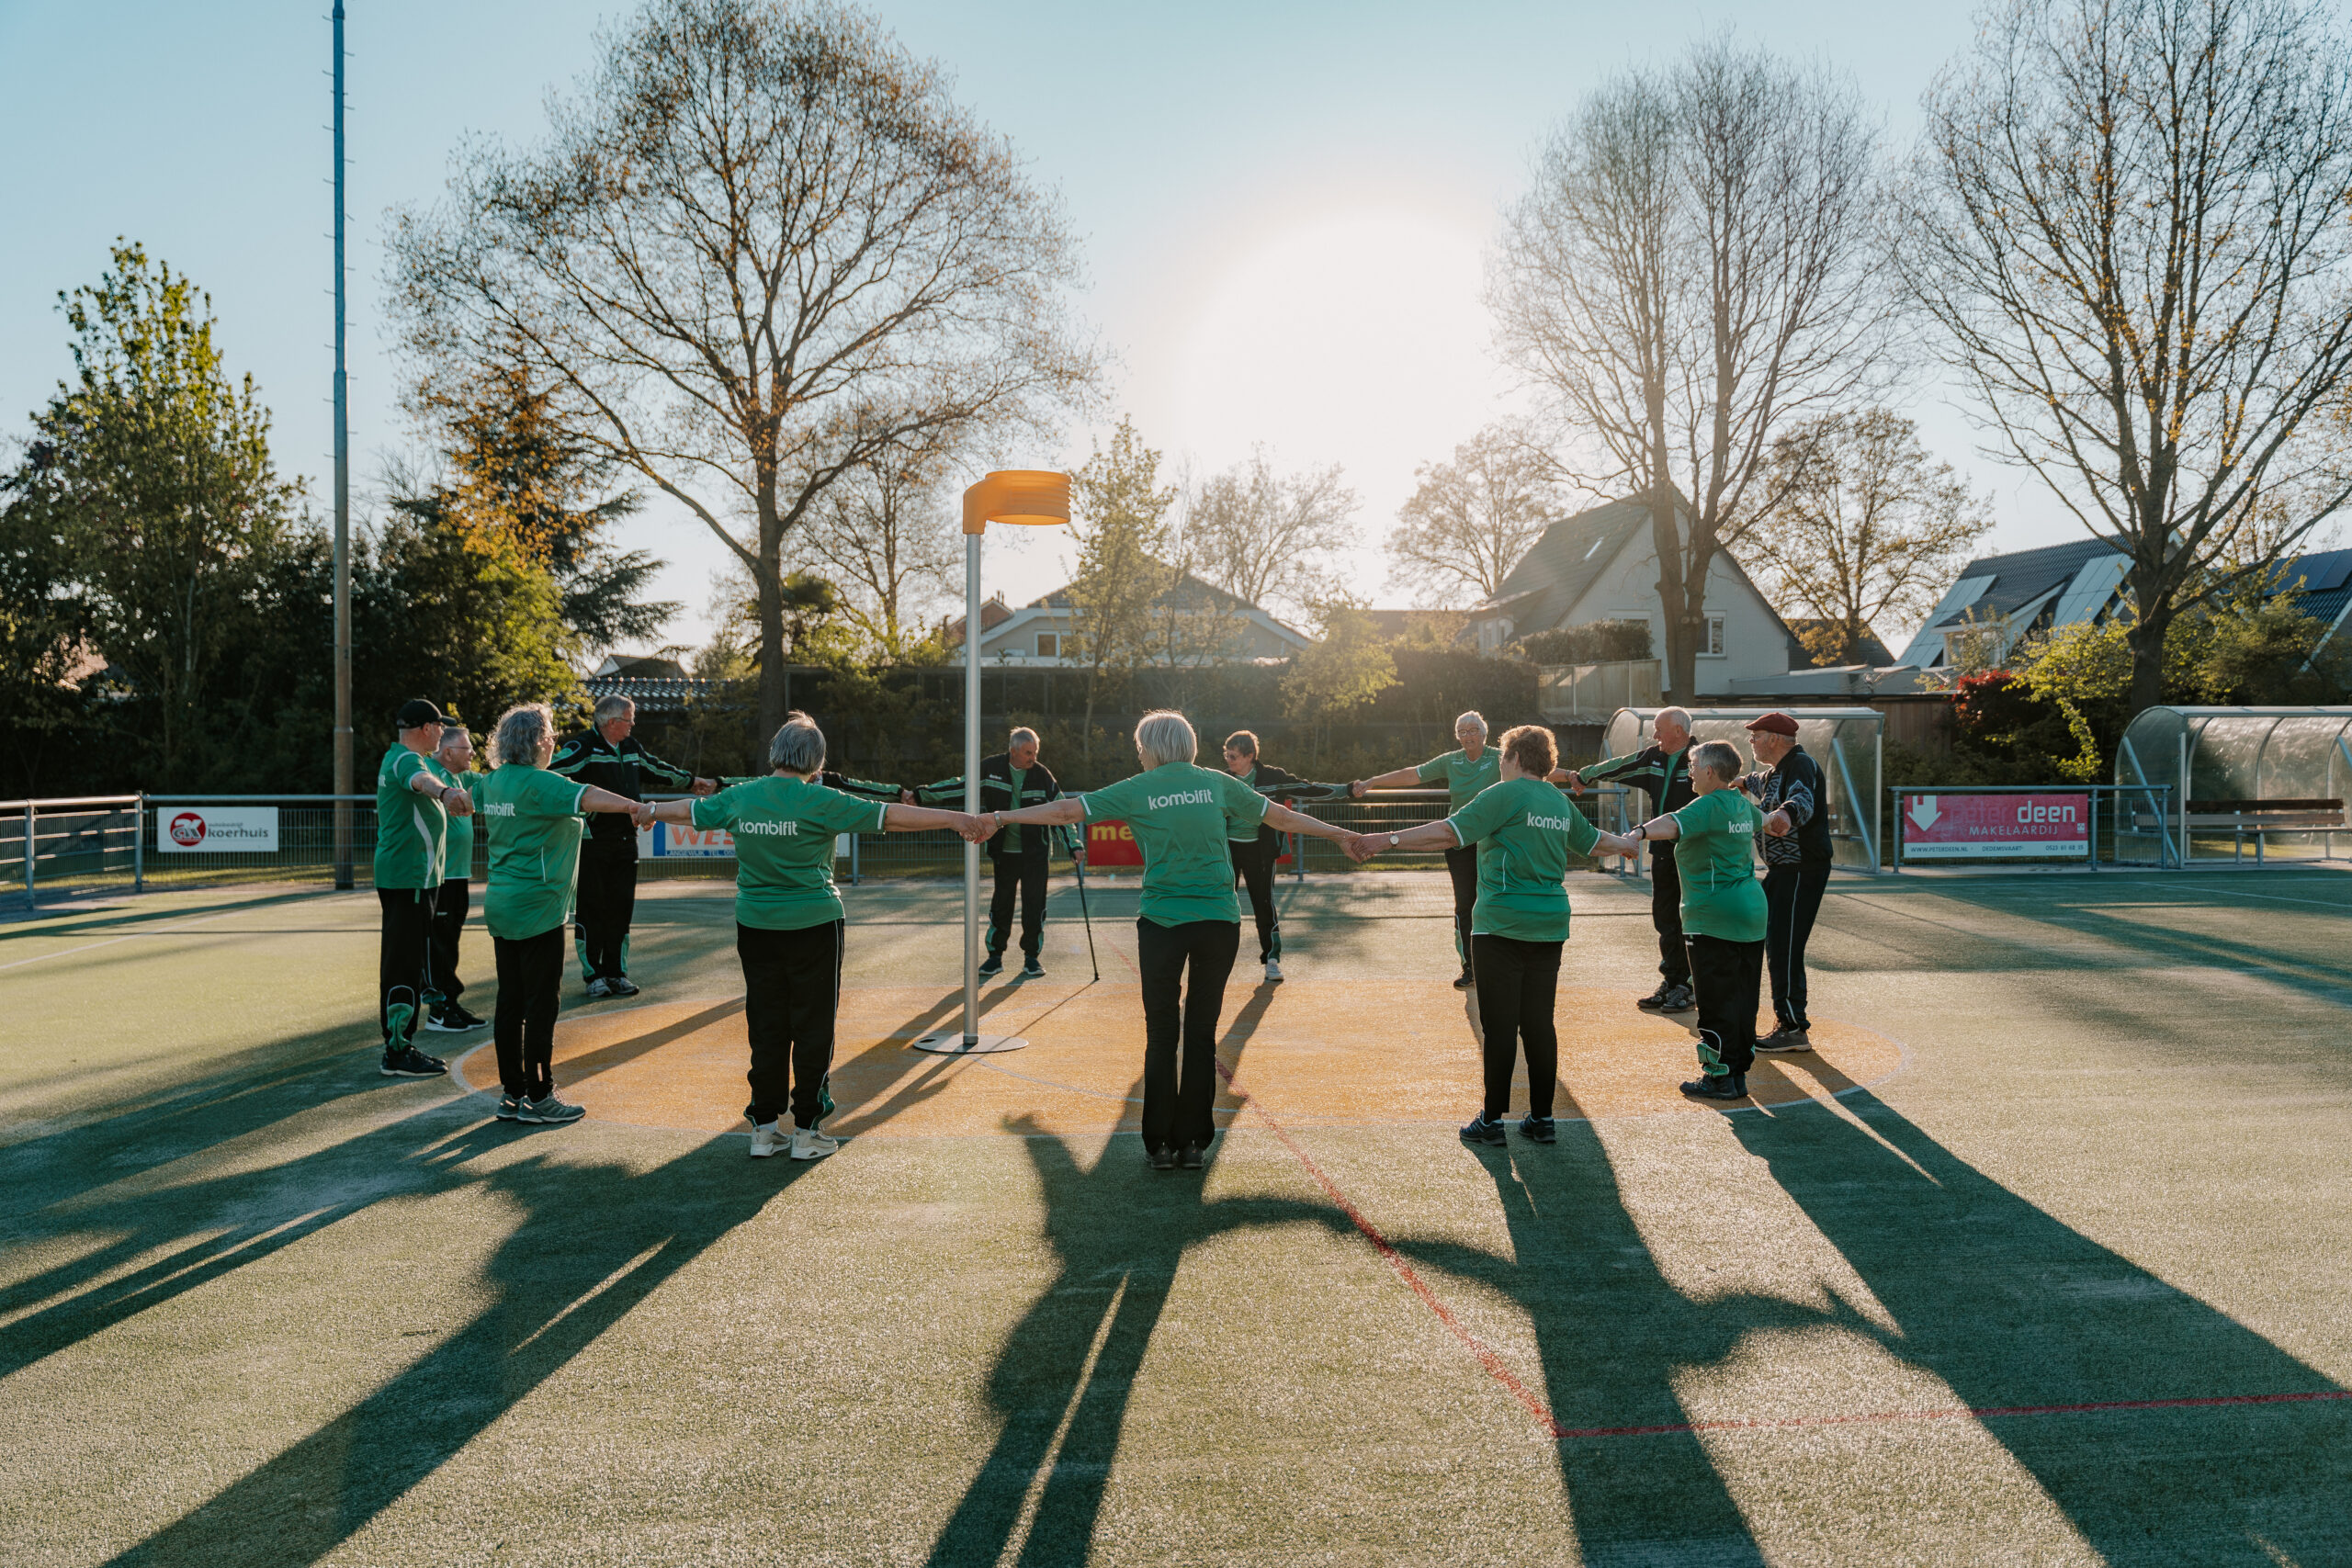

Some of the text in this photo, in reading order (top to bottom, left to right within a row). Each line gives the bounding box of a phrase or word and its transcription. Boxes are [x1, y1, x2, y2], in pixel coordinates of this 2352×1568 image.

[1148, 789, 1213, 810] kombifit
[2018, 800, 2076, 823] deen
[208, 827, 269, 838] koerhuis
[739, 818, 798, 836] kombifit
[1091, 825, 1135, 840] me
[1969, 825, 2059, 837] MAKELAARDIJ
